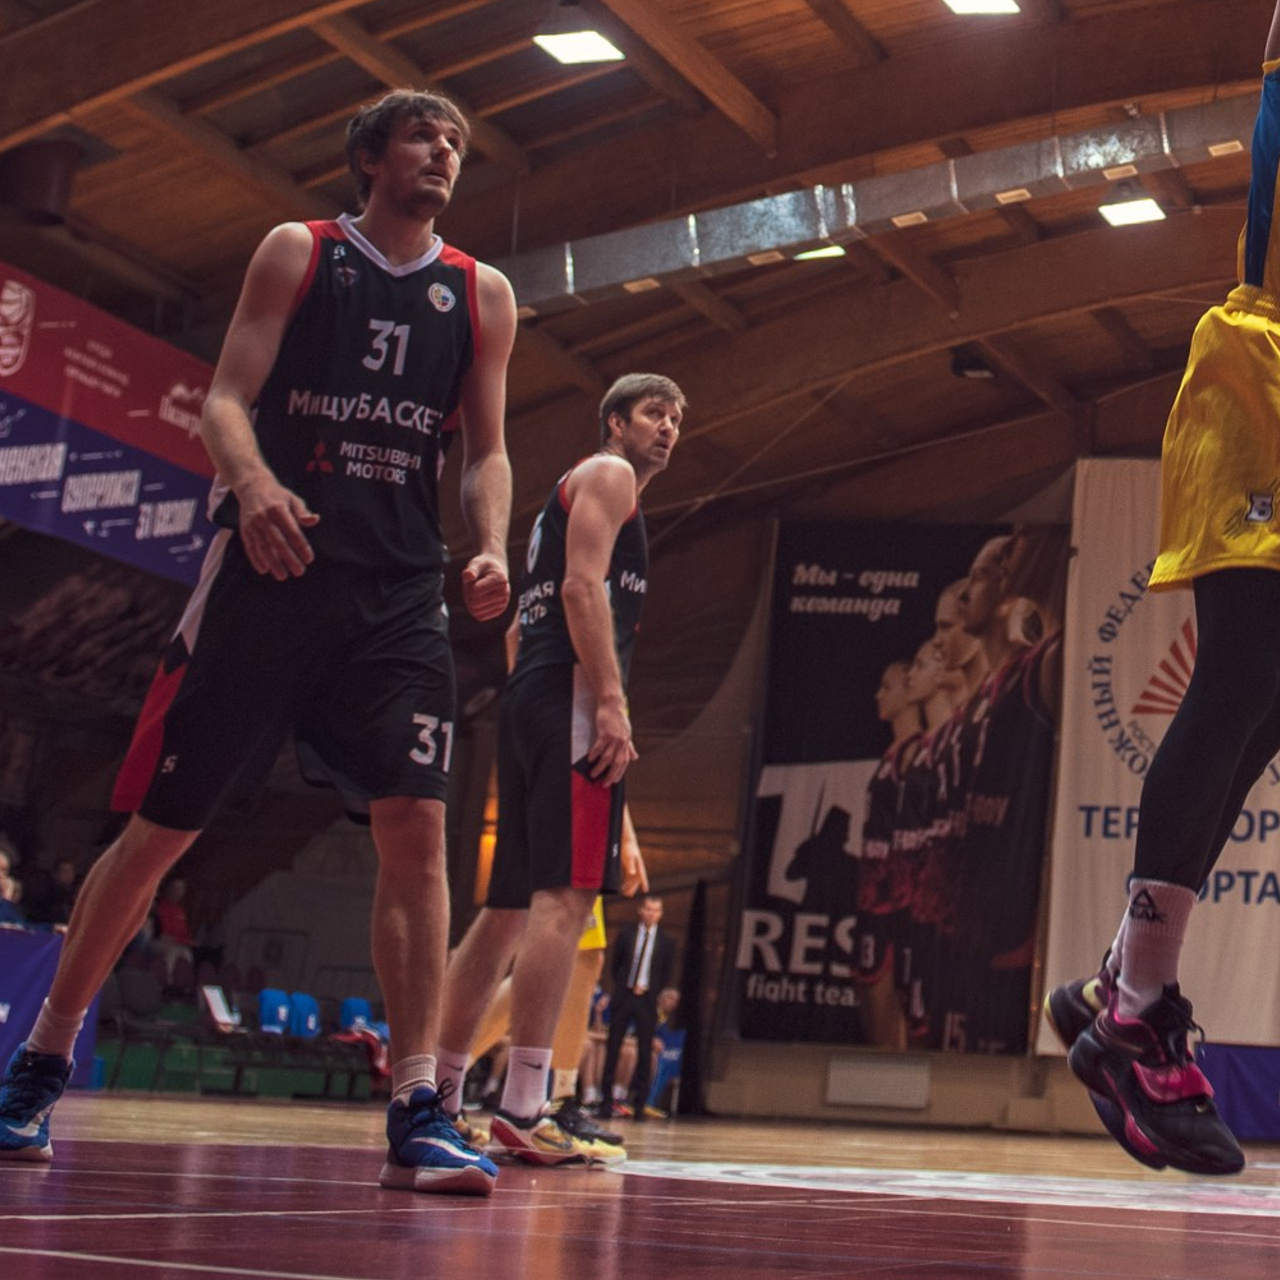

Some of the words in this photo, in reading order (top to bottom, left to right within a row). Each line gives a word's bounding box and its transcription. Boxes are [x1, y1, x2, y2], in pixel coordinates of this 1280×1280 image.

[362, 319, 411, 376] 31
[287, 389, 446, 437] МицуБАСКЕ
[793, 563, 838, 587] Мы
[790, 596, 901, 622] команда
[408, 712, 454, 774] 31
[746, 973, 808, 1004] fight
[815, 981, 860, 1007] tea
